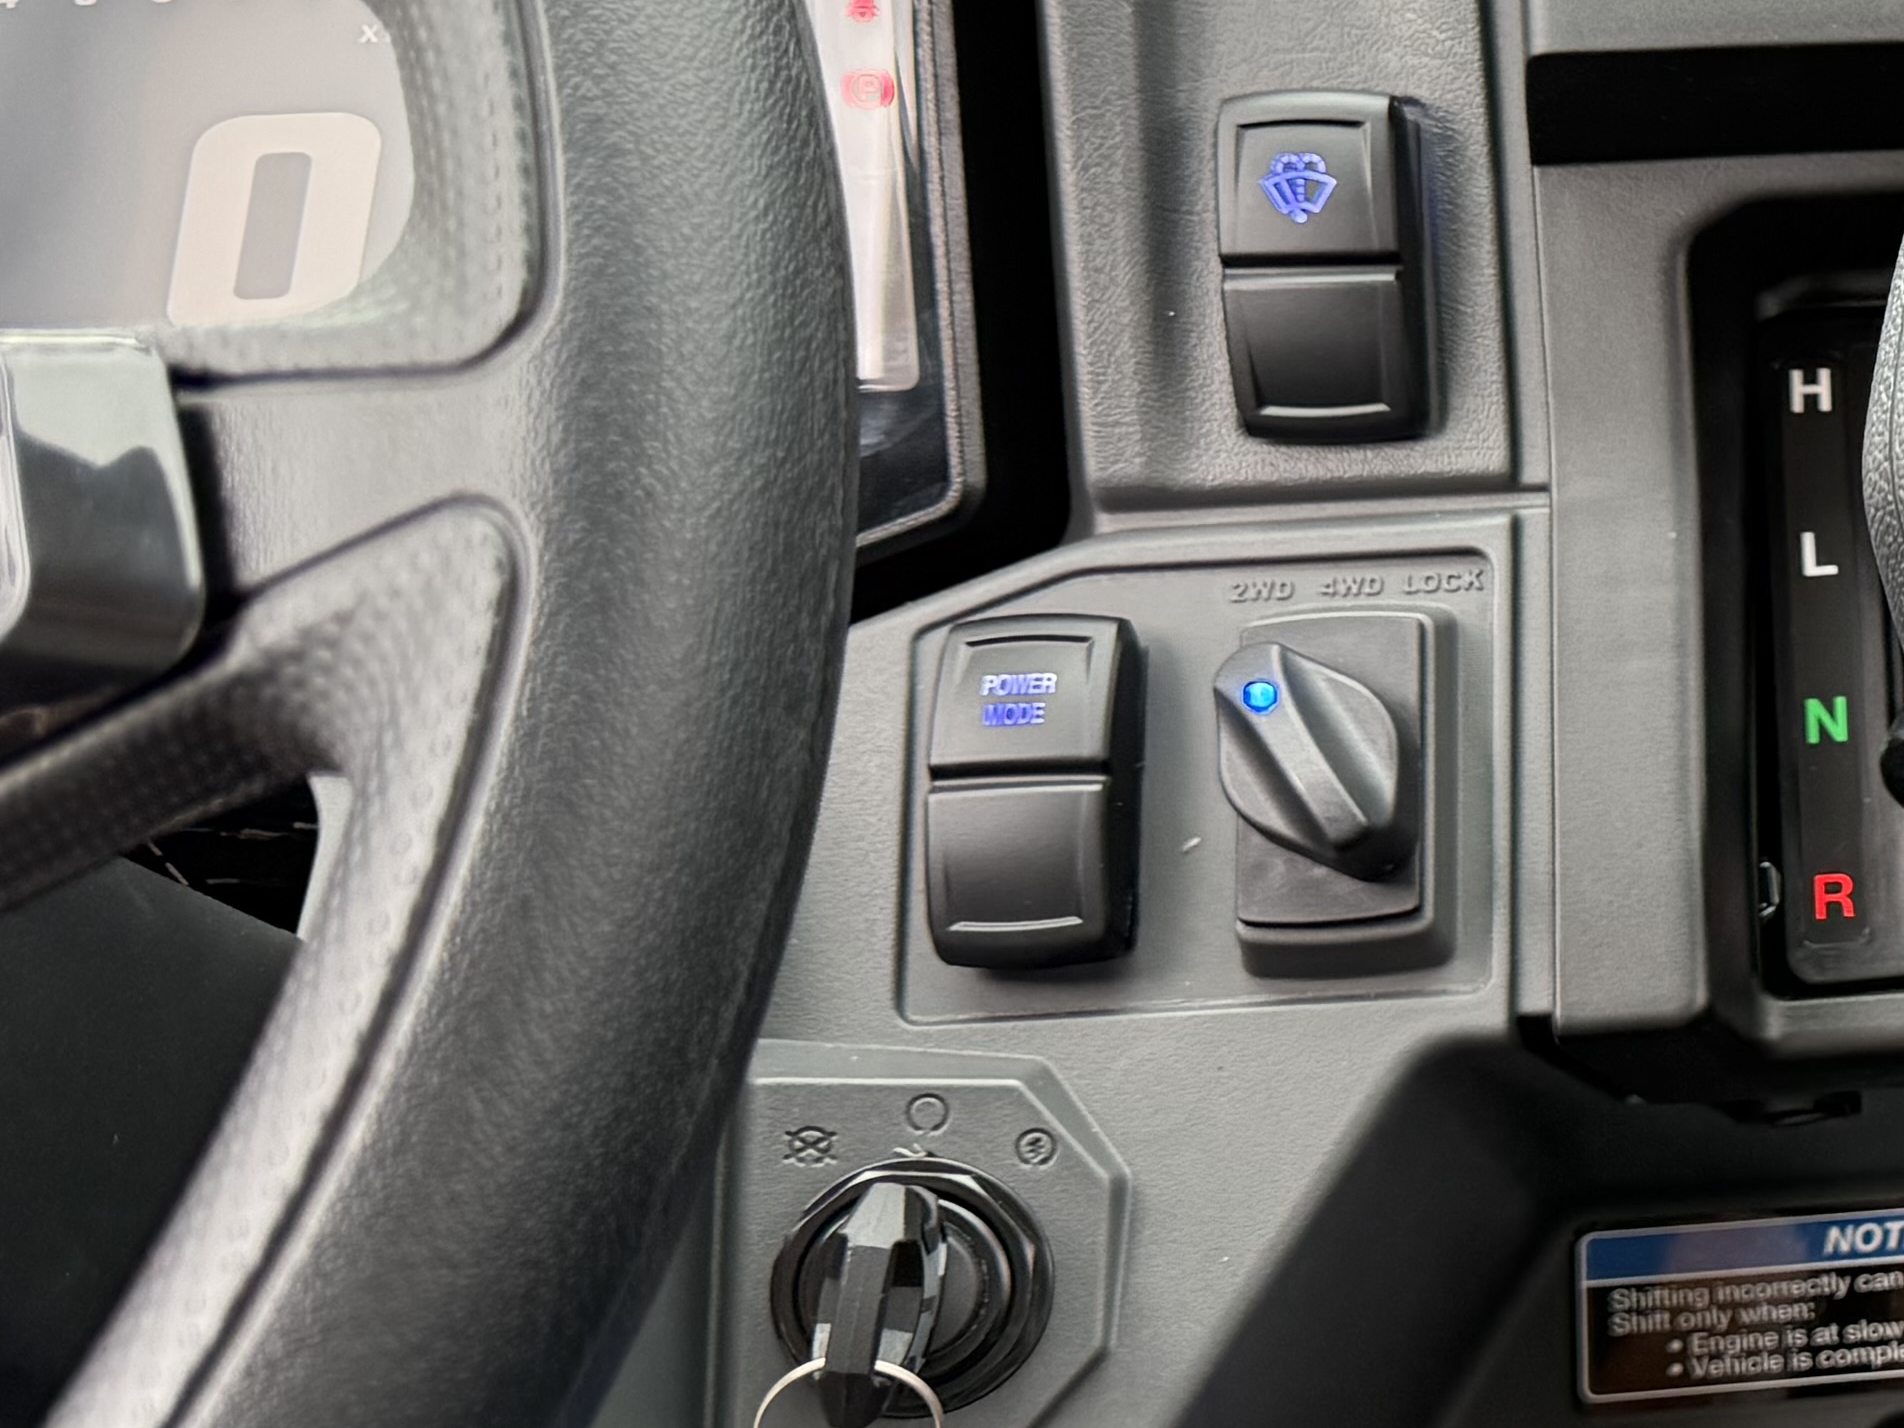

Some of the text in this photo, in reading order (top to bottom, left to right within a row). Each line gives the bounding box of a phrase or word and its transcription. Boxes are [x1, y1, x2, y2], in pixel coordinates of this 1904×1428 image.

[166, 113, 381, 328] 0
[1788, 368, 1831, 413] H
[1800, 532, 1838, 576] L
[1230, 569, 1484, 603] 2WD 4WD LOCK
[980, 673, 1057, 697] POWER
[982, 702, 1046, 727] MODE
[1805, 696, 1849, 744] N
[1812, 872, 1854, 920] R
[1607, 1284, 1710, 1312] Shifting
[1712, 1272, 1851, 1304] incorrectly
[1854, 1270, 1904, 1293] can
[1607, 1300, 1817, 1337] Shift only when:
[1687, 1329, 1780, 1357] Engine
[1786, 1325, 1808, 1348] is
[1810, 1323, 1840, 1346] at
[1686, 1351, 1785, 1380] Vehicle
[1789, 1348, 1813, 1372] is
